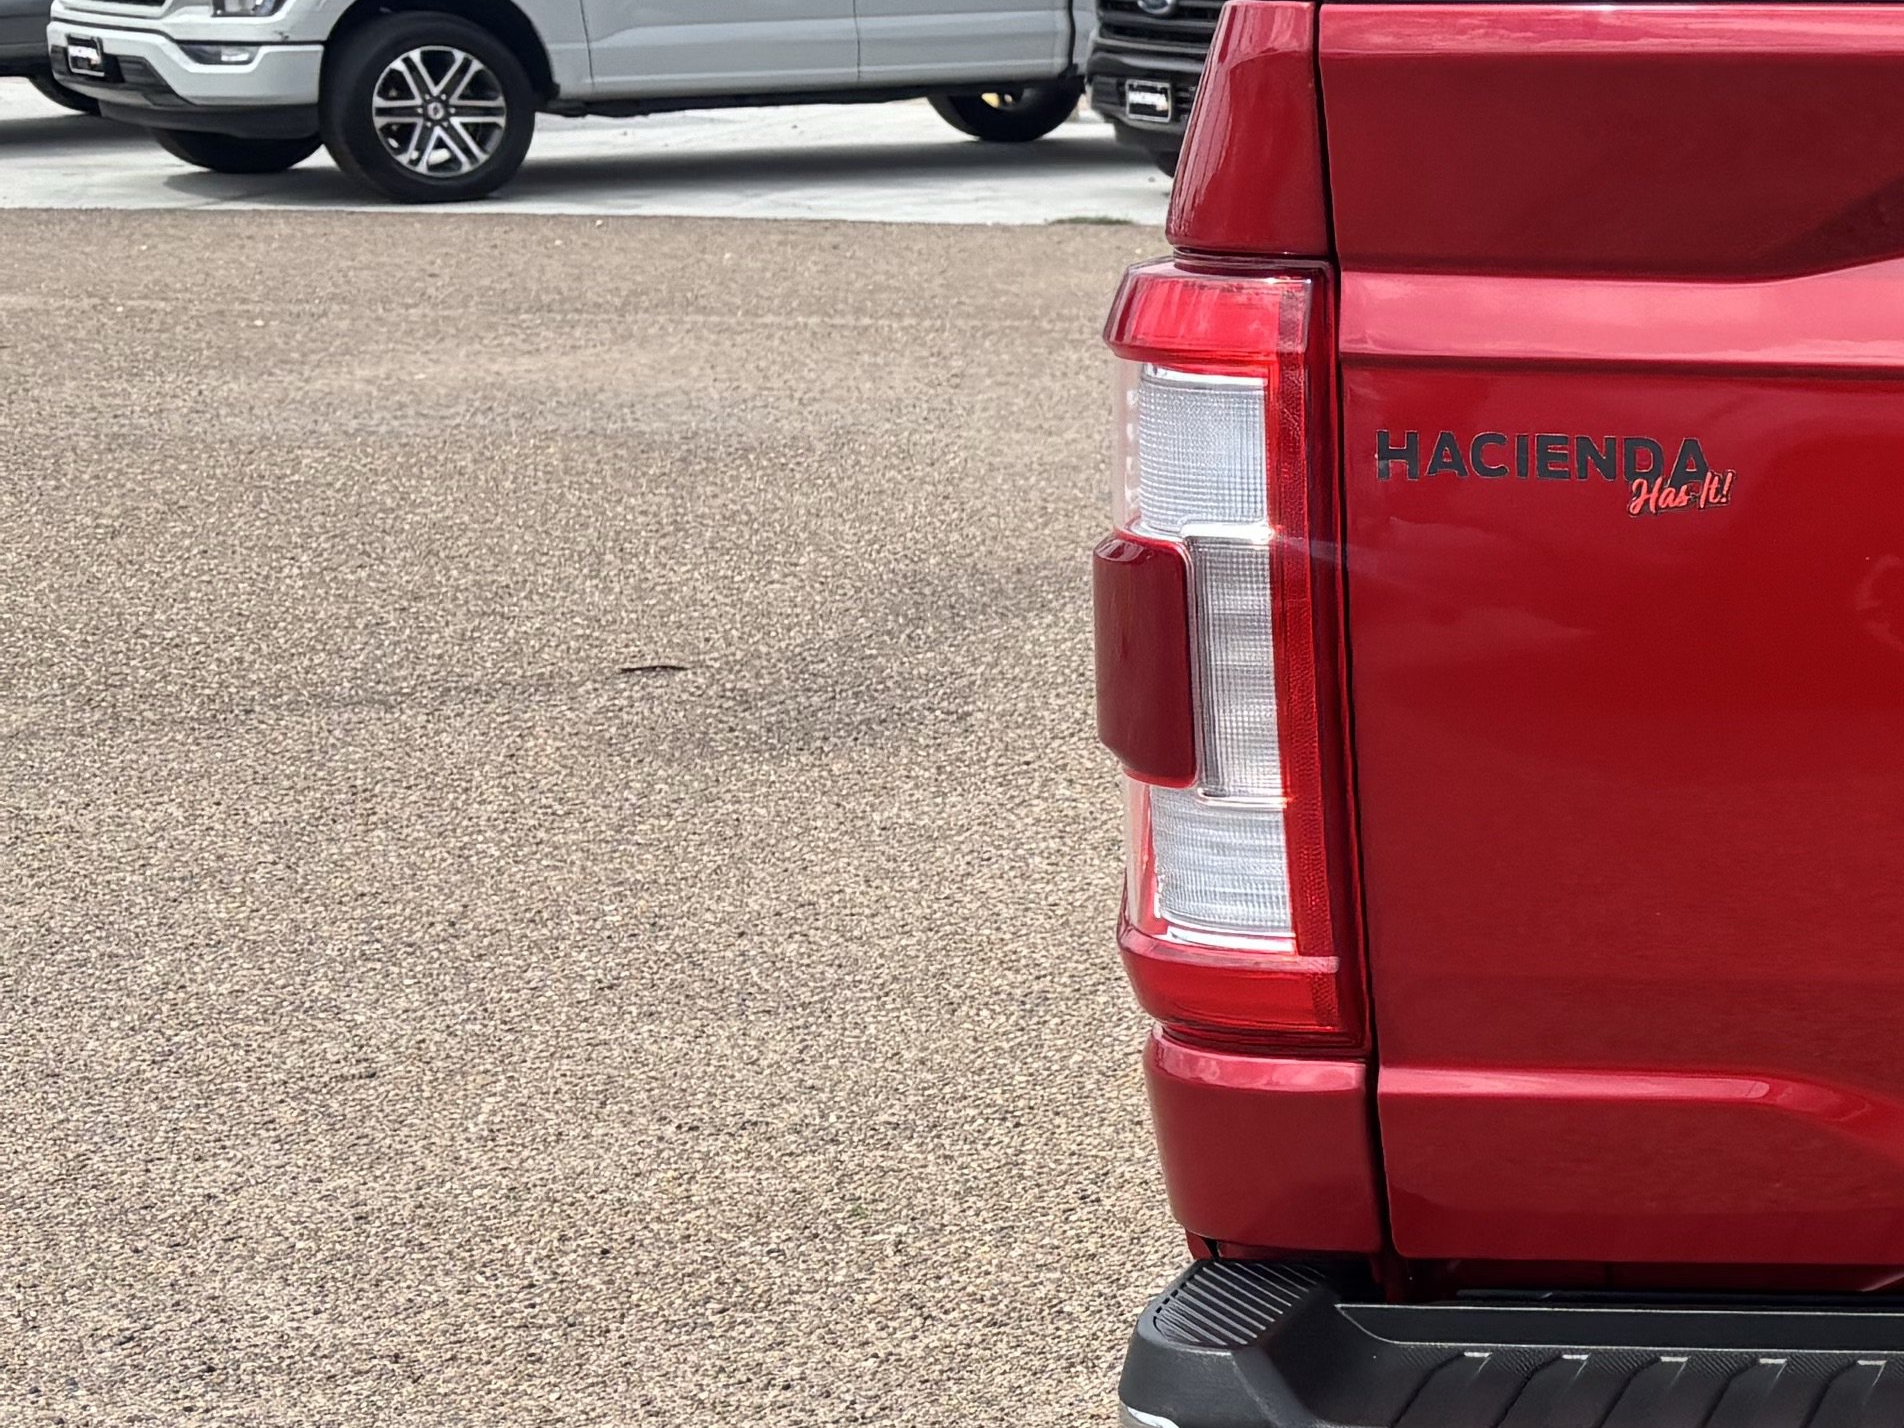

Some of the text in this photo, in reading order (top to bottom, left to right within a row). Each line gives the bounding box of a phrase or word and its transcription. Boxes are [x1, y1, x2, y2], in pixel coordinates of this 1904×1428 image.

[1376, 430, 1710, 488] HACIENDA
[1629, 470, 1734, 515] Has It!
